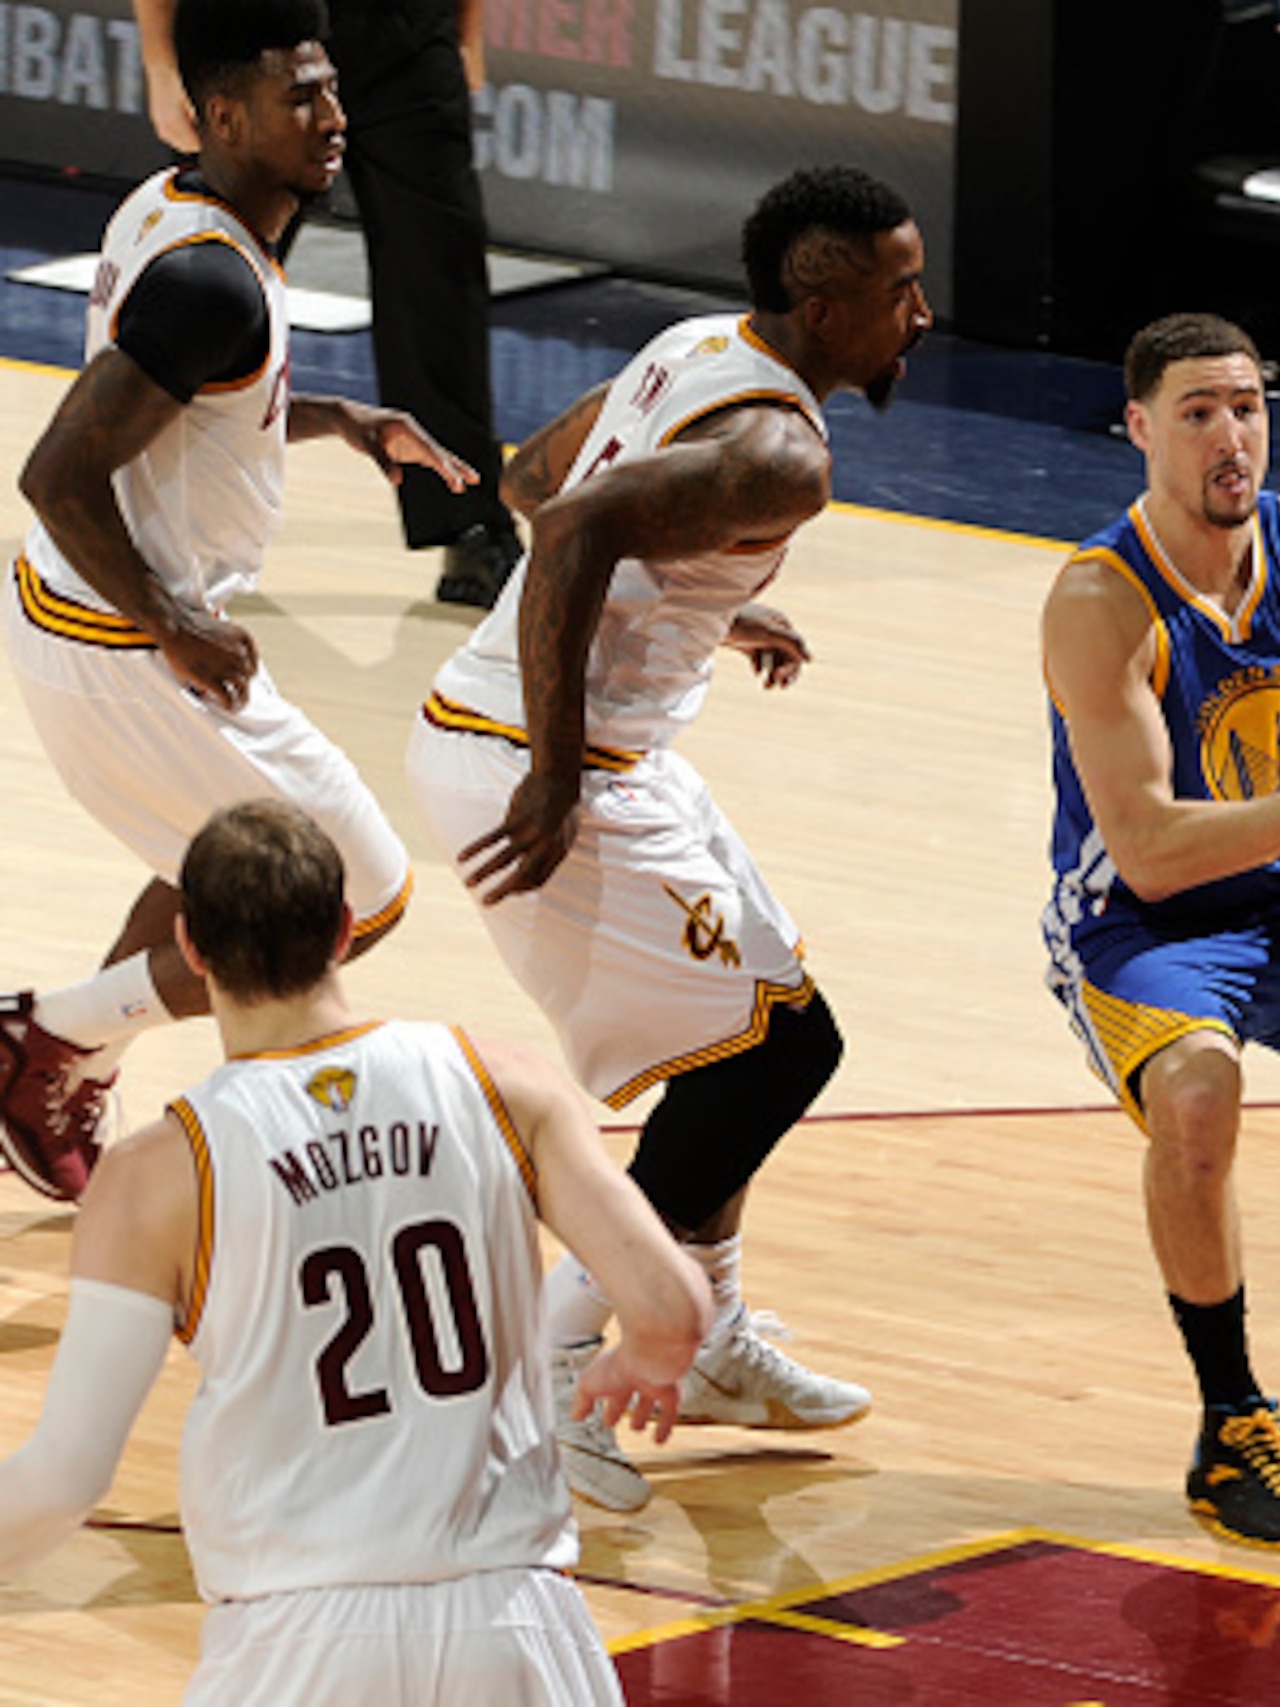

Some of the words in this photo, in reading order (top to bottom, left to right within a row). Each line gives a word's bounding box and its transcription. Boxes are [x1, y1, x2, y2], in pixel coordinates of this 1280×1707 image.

[653, 0, 957, 123] LEAGUE
[269, 1122, 440, 1206] MOZGOV
[300, 1219, 489, 1427] 20
